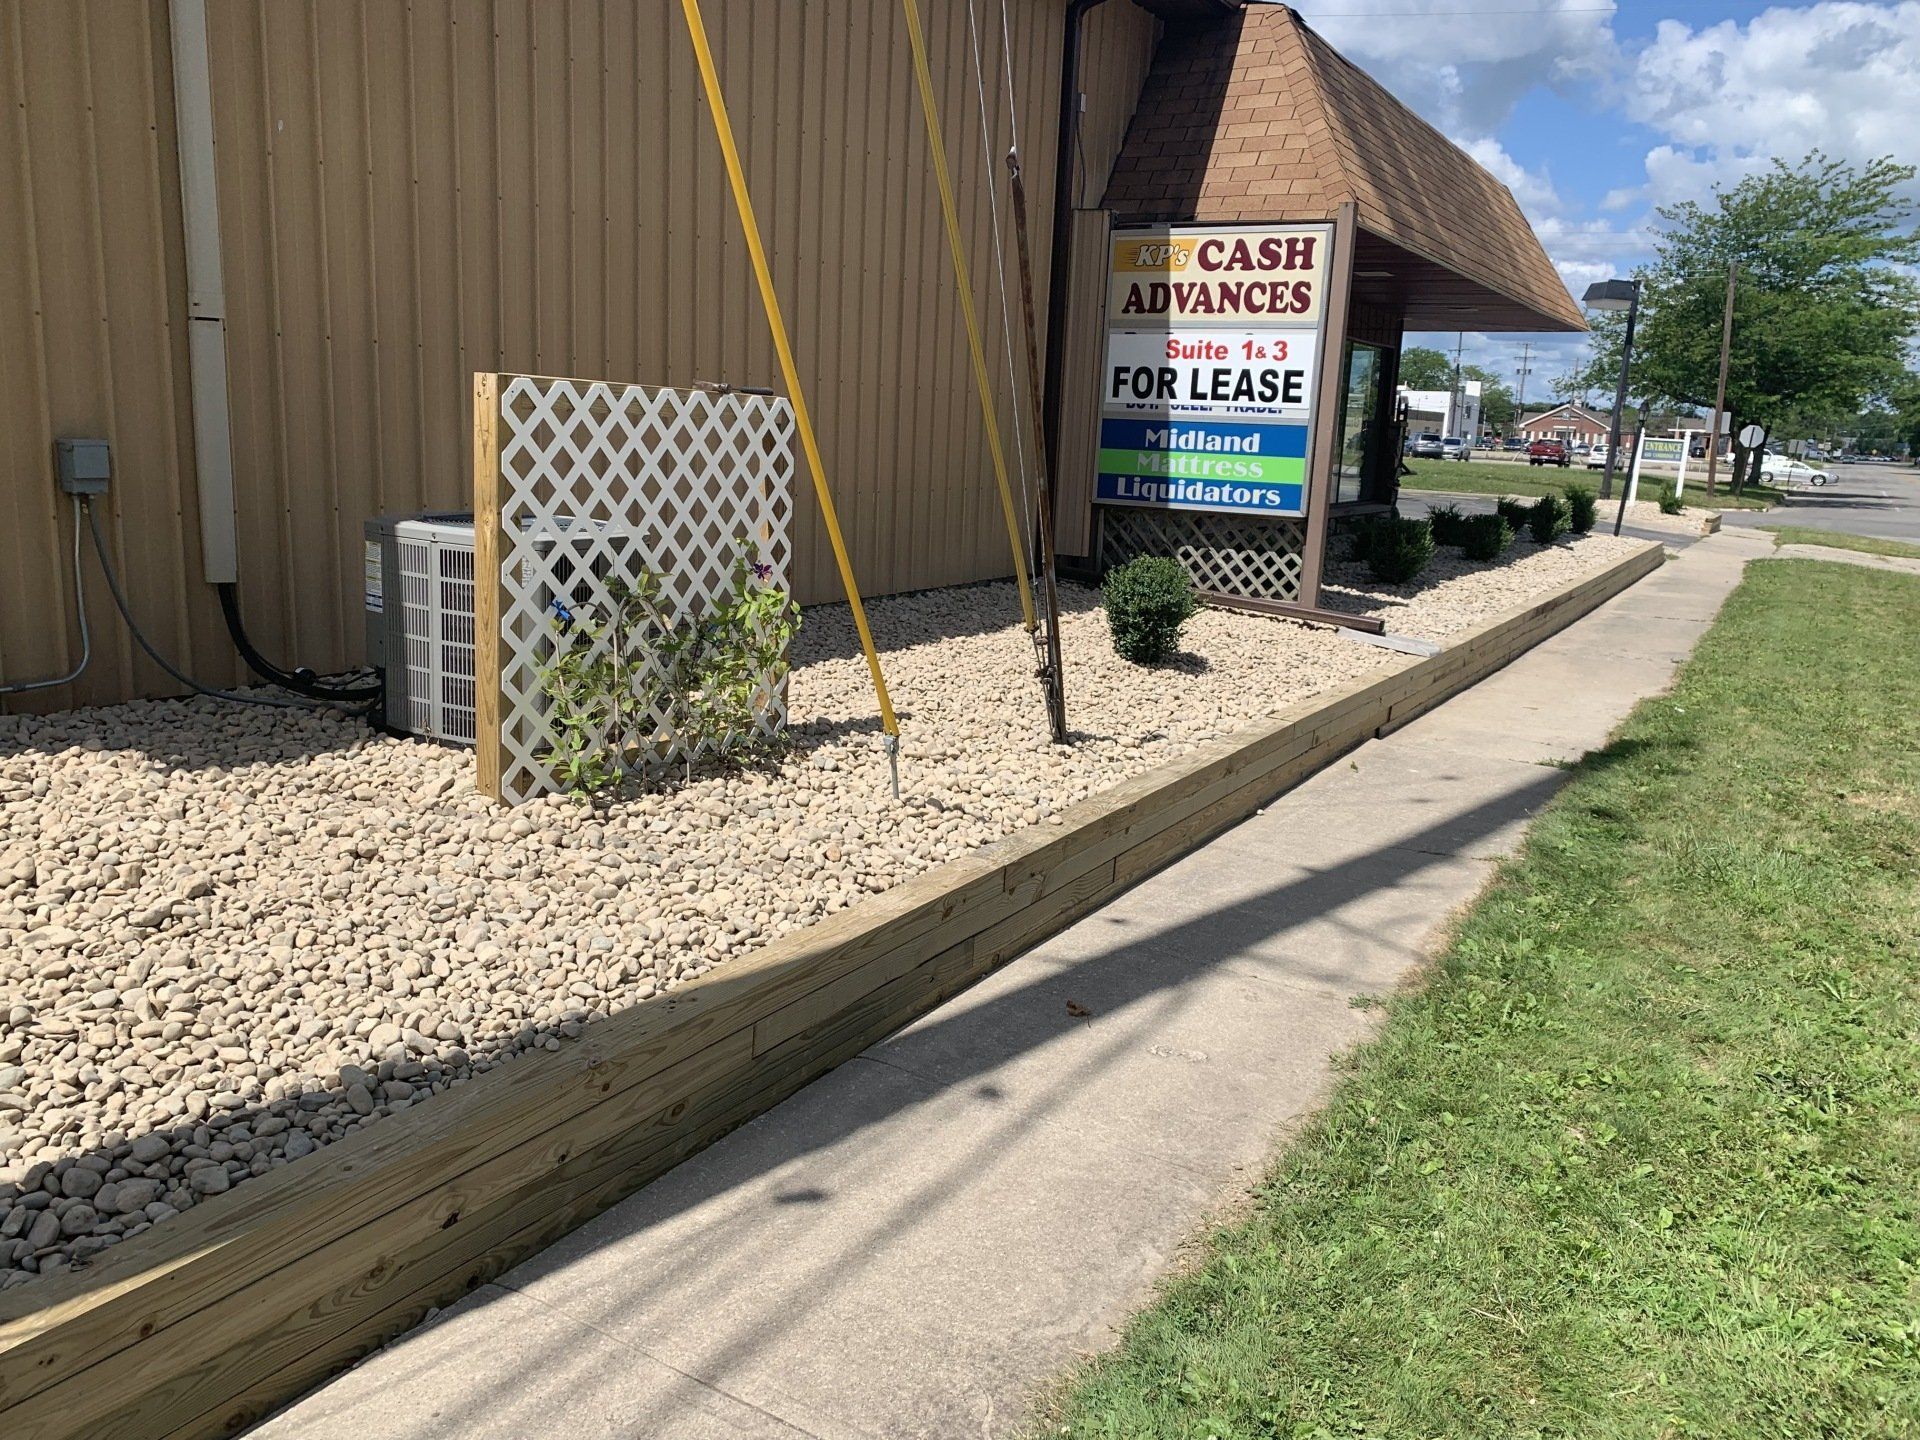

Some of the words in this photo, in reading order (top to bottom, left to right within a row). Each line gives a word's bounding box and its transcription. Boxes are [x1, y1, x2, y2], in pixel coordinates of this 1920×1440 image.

[1197, 236, 1317, 272] CASH
[1121, 280, 1312, 314] ADVANCES
[1165, 339, 1229, 361] Suite
[1112, 366, 1178, 400] FOR
[1190, 367, 1305, 403] LEASE
[1145, 428, 1260, 453] Midland
[1645, 441, 1682, 452] ENTRANCE
[1137, 453, 1263, 477] Mattress
[1116, 476, 1281, 506] Liquidators
